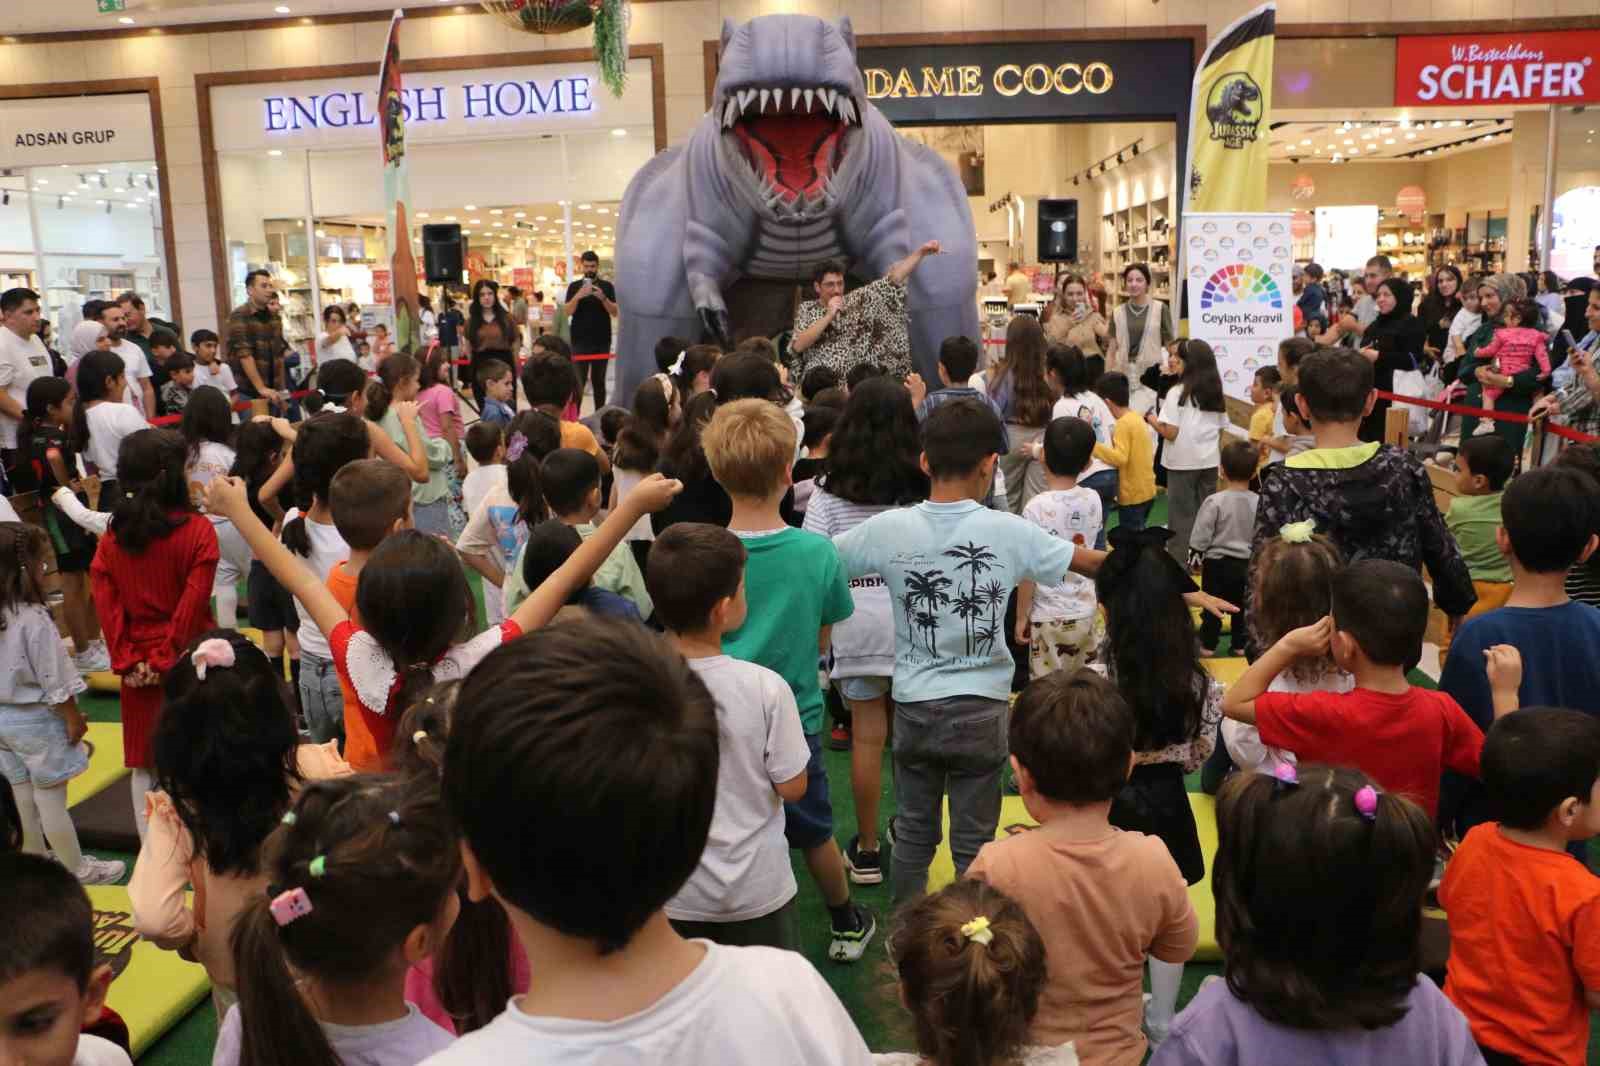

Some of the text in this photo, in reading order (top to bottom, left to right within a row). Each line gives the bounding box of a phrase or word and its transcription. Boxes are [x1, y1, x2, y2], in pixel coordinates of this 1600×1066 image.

[993, 62, 1113, 96] COCO
[264, 78, 592, 130] ENGLSH HOME
[15, 130, 115, 147] ADSAN GRUP
[1202, 313, 1283, 325] Ceylan Karavil
[1229, 325, 1255, 335] Park
